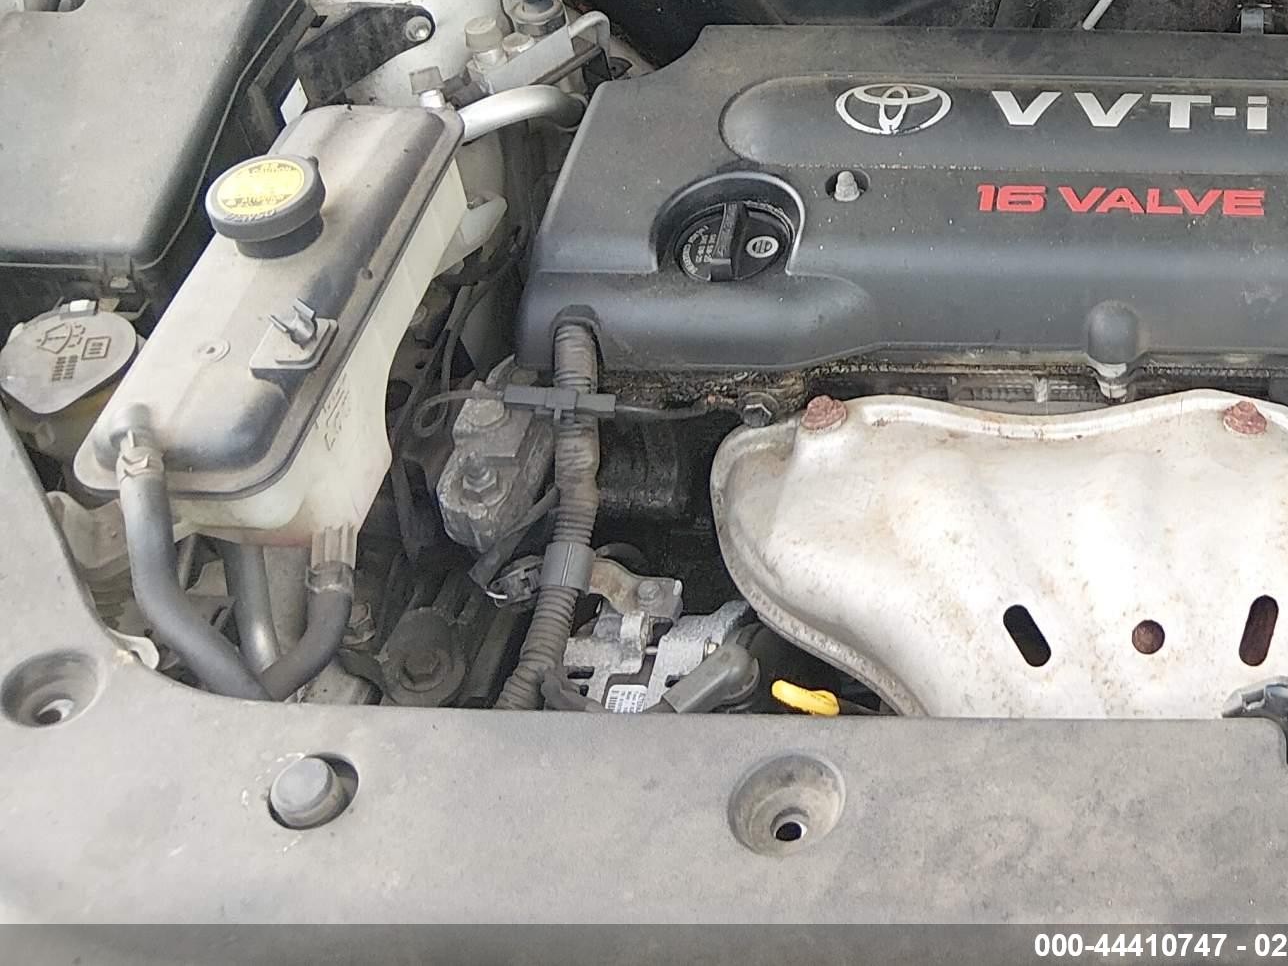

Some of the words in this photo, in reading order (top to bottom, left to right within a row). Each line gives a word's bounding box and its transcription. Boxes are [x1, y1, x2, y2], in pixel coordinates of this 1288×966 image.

[991, 90, 1268, 131] VVT-i
[977, 184, 1047, 213] 16
[1057, 186, 1266, 217] VALVE
